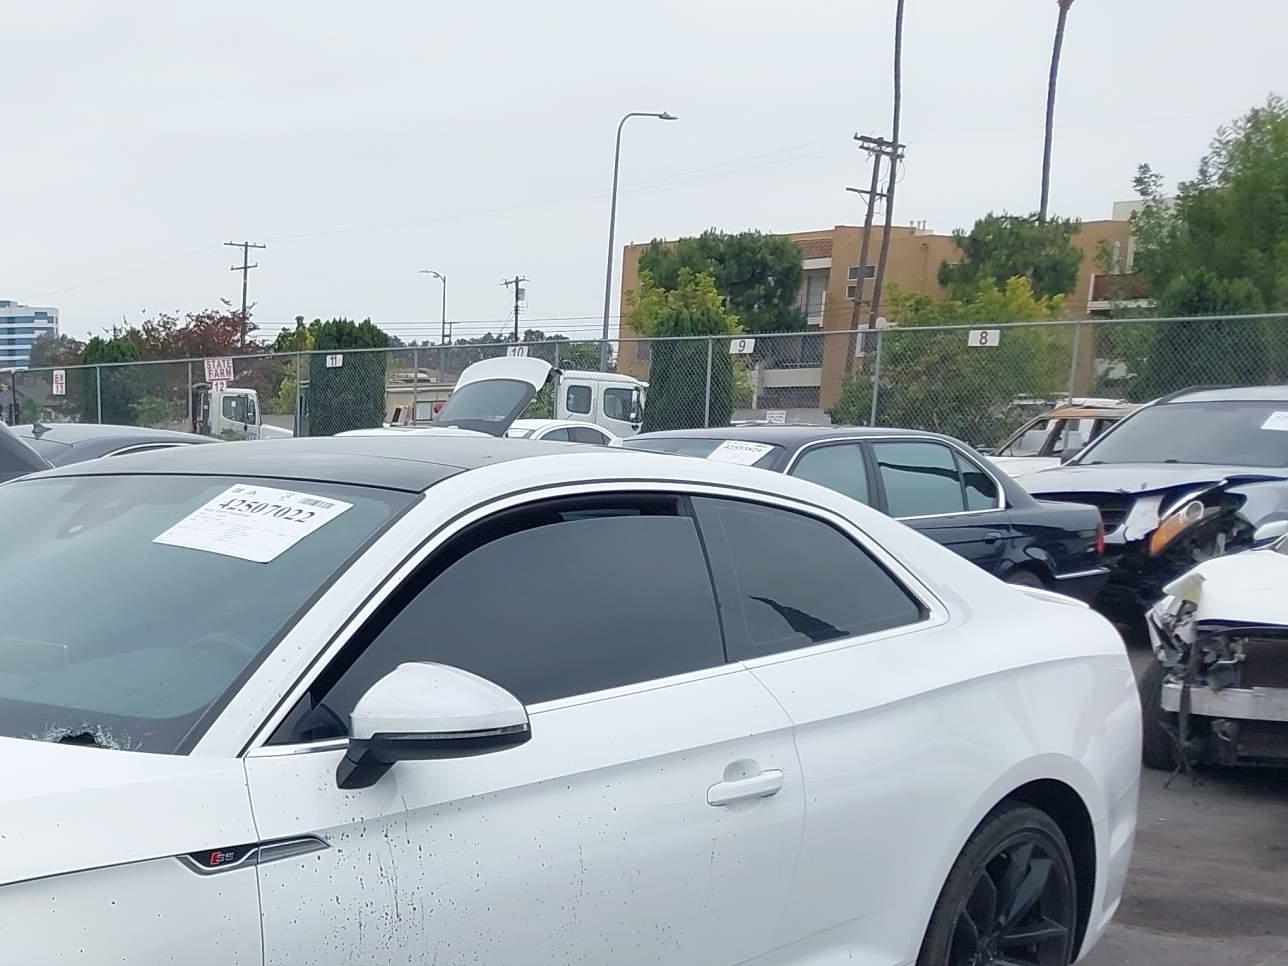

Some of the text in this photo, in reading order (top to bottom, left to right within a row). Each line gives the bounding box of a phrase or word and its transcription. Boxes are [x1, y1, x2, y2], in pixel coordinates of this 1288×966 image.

[979, 331, 988, 345] 8
[738, 340, 746, 352] 9
[512, 347, 524, 357] 10
[206, 359, 232, 369] STATE
[208, 369, 232, 378] FARM
[214, 381, 225, 392] 12
[218, 498, 316, 523] 42507022
